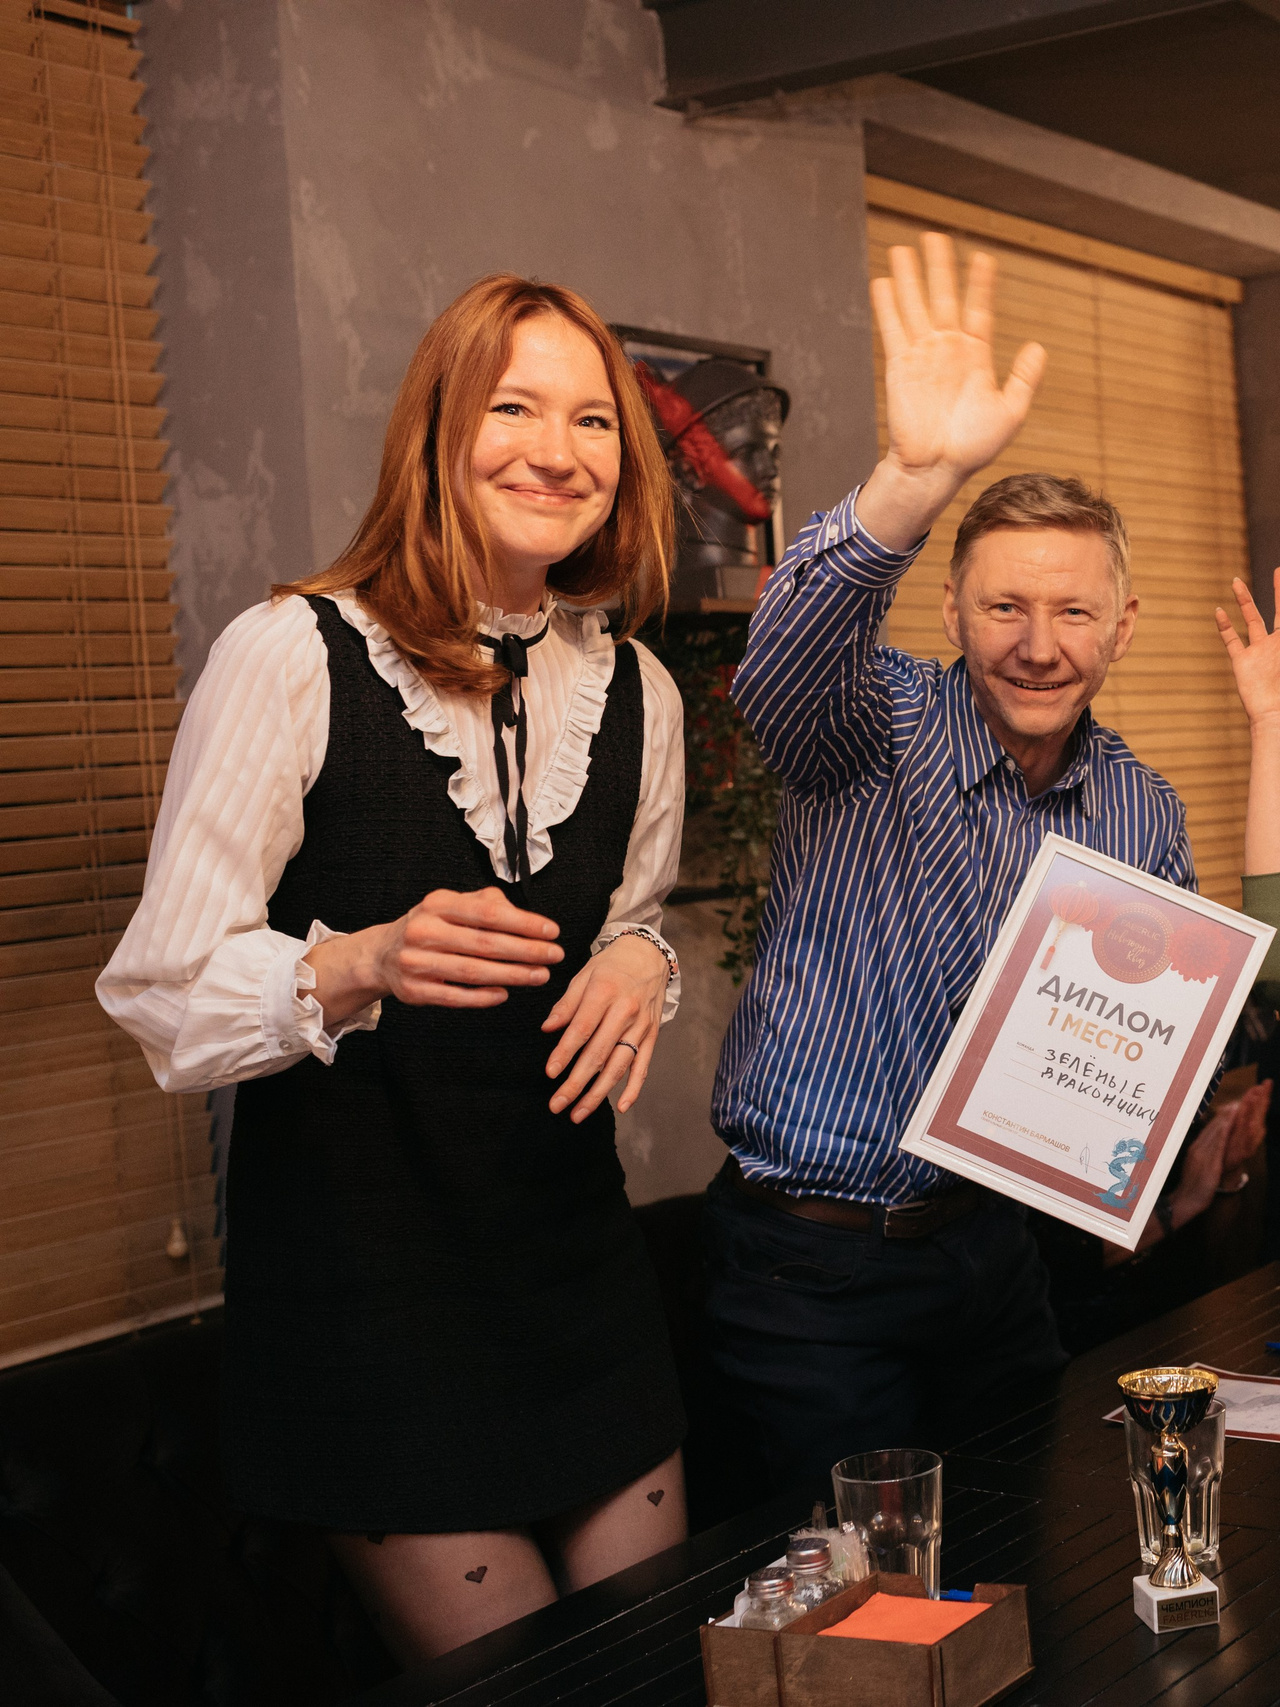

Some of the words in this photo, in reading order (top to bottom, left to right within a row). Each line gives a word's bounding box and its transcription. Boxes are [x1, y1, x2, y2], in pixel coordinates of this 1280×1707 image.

[1036, 974, 1176, 1046] ДИПЛОМ
[1047, 1006, 1060, 1027] 1
[1060, 1012, 1144, 1062] МЕСТО
[1044, 1048, 1146, 1099] ЗЕЛЁНЫЕ
[982, 1109, 1030, 1135] КОНСТАНТИН
[1029, 1131, 1071, 1153] БАРМАШОВ
[1161, 1596, 1214, 1613] ЧЕМПИОН
